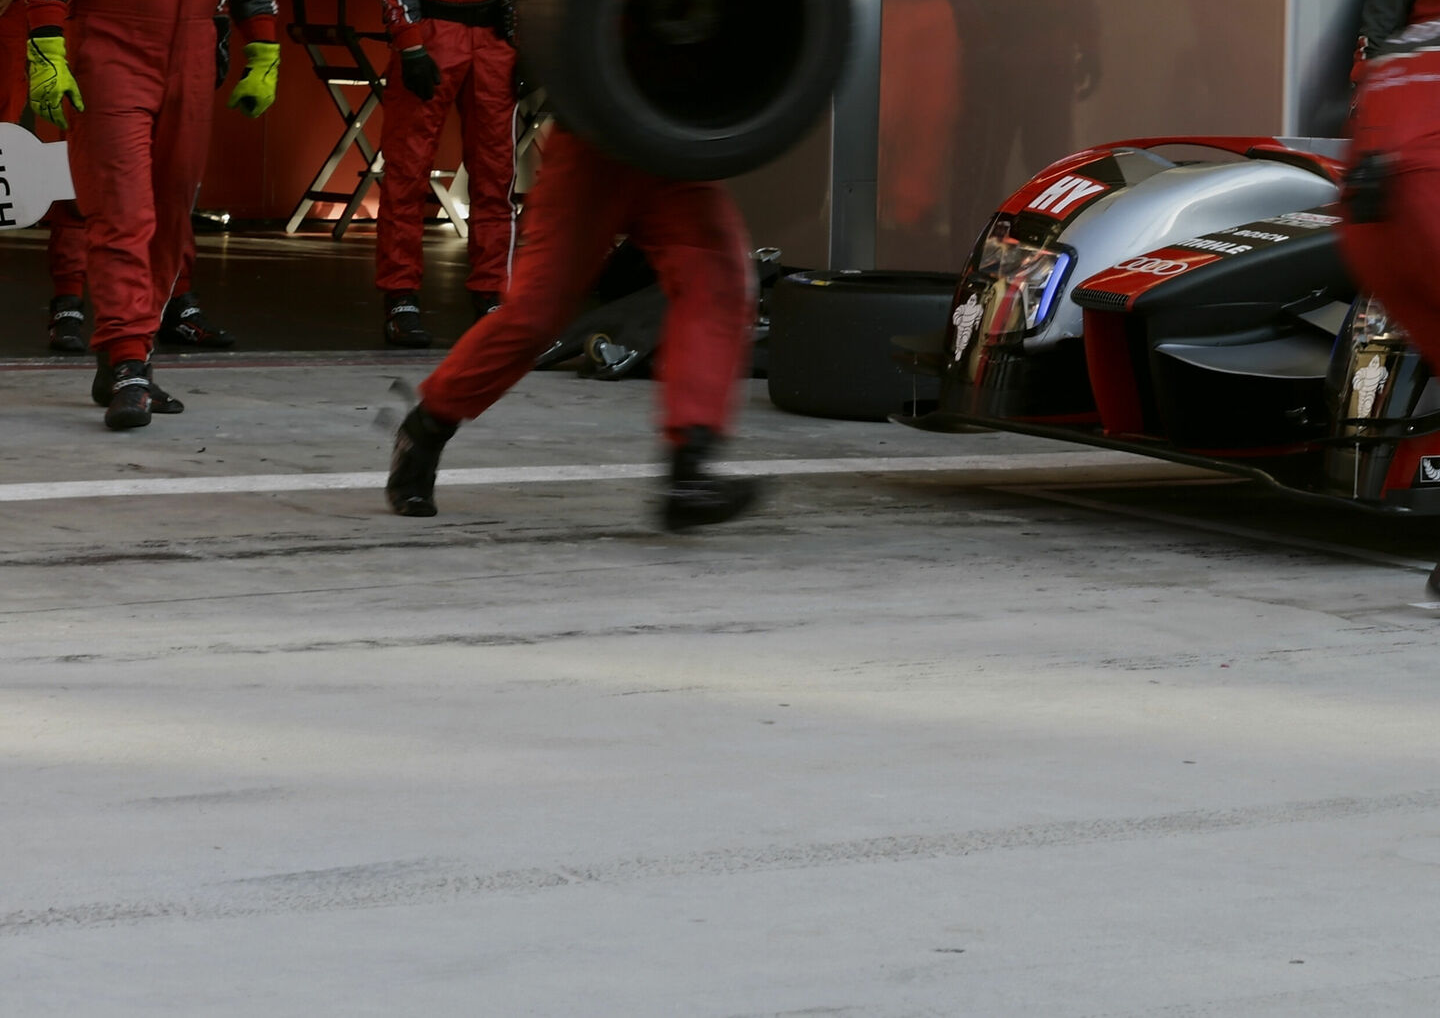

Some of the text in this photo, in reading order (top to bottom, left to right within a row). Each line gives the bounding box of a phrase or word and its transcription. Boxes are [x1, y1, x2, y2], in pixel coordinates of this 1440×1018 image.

[1027, 175, 1104, 214] HY
[1232, 229, 1290, 242] BOSCH
[1176, 238, 1254, 255] MAHLE
